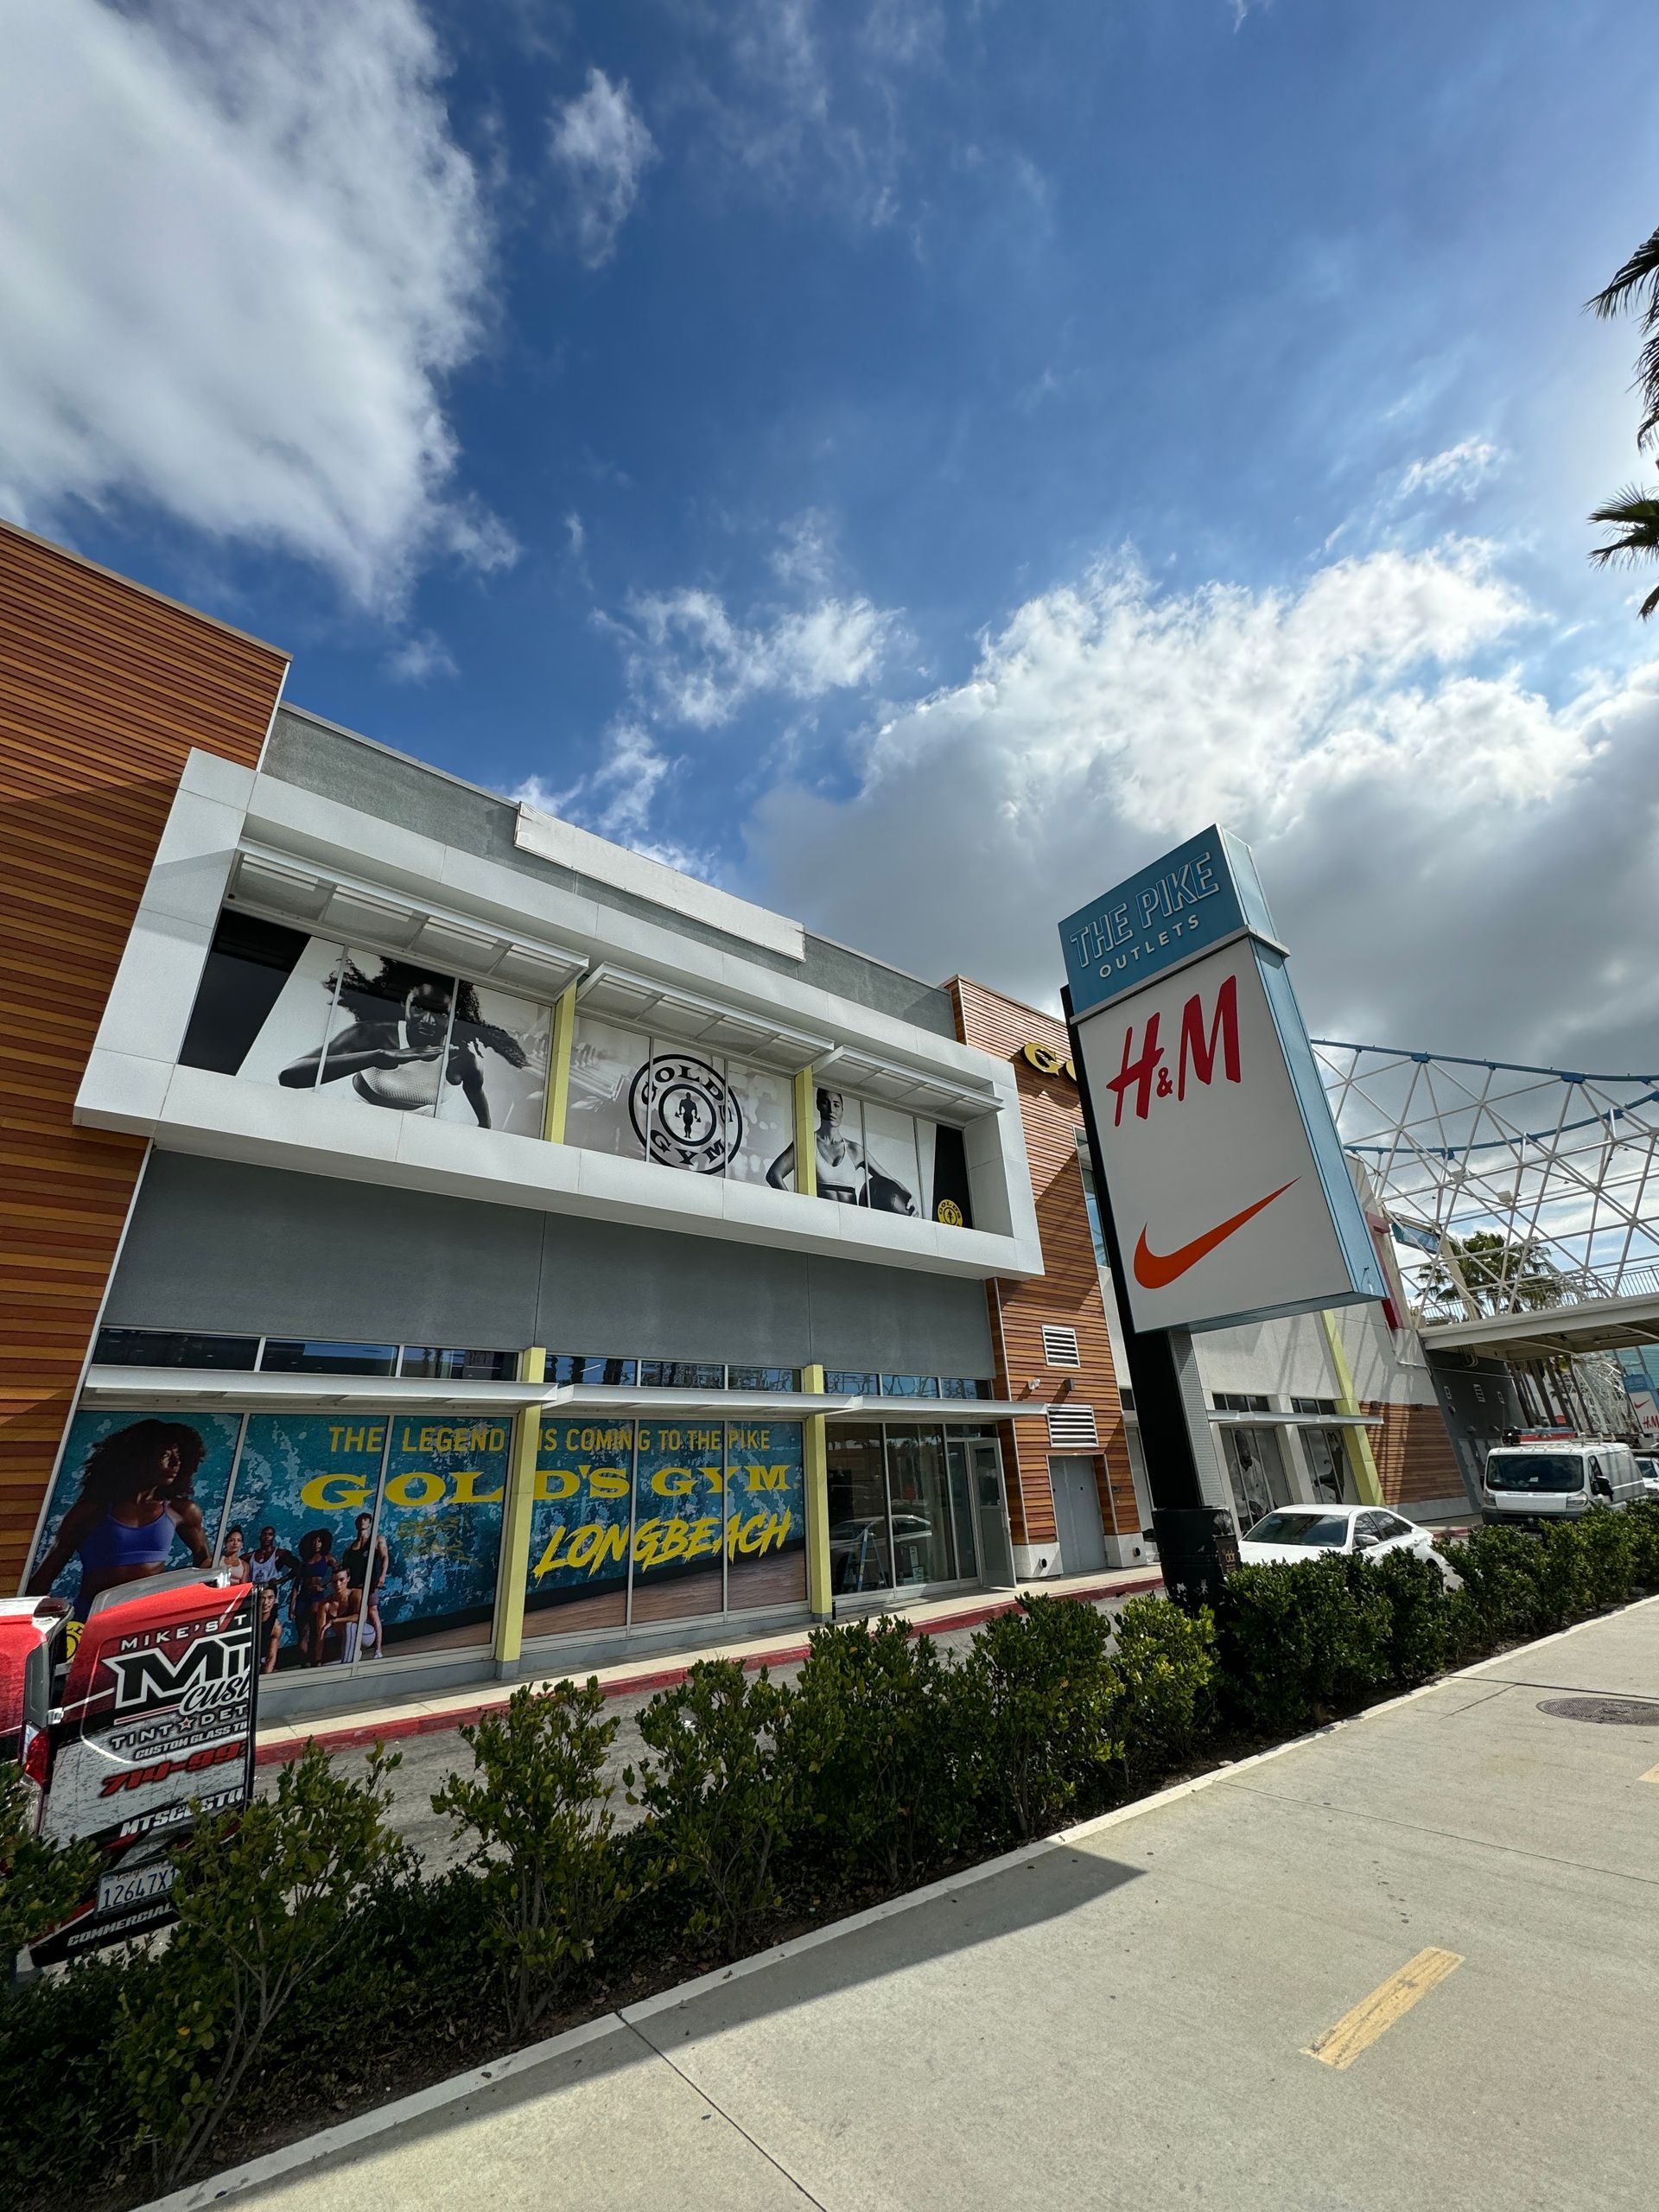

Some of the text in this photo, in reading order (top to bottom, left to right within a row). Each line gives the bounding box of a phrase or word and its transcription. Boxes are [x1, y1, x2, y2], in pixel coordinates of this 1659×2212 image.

[1069, 851, 1220, 969] THE PIKE
[1098, 914, 1200, 978] OUTLETS
[1106, 975, 1242, 1128] H&M
[650, 1129, 728, 1166] GYM
[328, 1427, 771, 1452] THE LEGEND IS COMING TO THE PIKE
[300, 1465, 792, 1510] GOLD'S GYM
[121, 1620, 219, 1652] MIKE'S
[111, 1704, 248, 1750] TINT DET
[135, 1734, 189, 1759] CUSTOM
[190, 1726, 231, 1743] GLASS
[67, 1902, 173, 1948] COMMERCIAL
